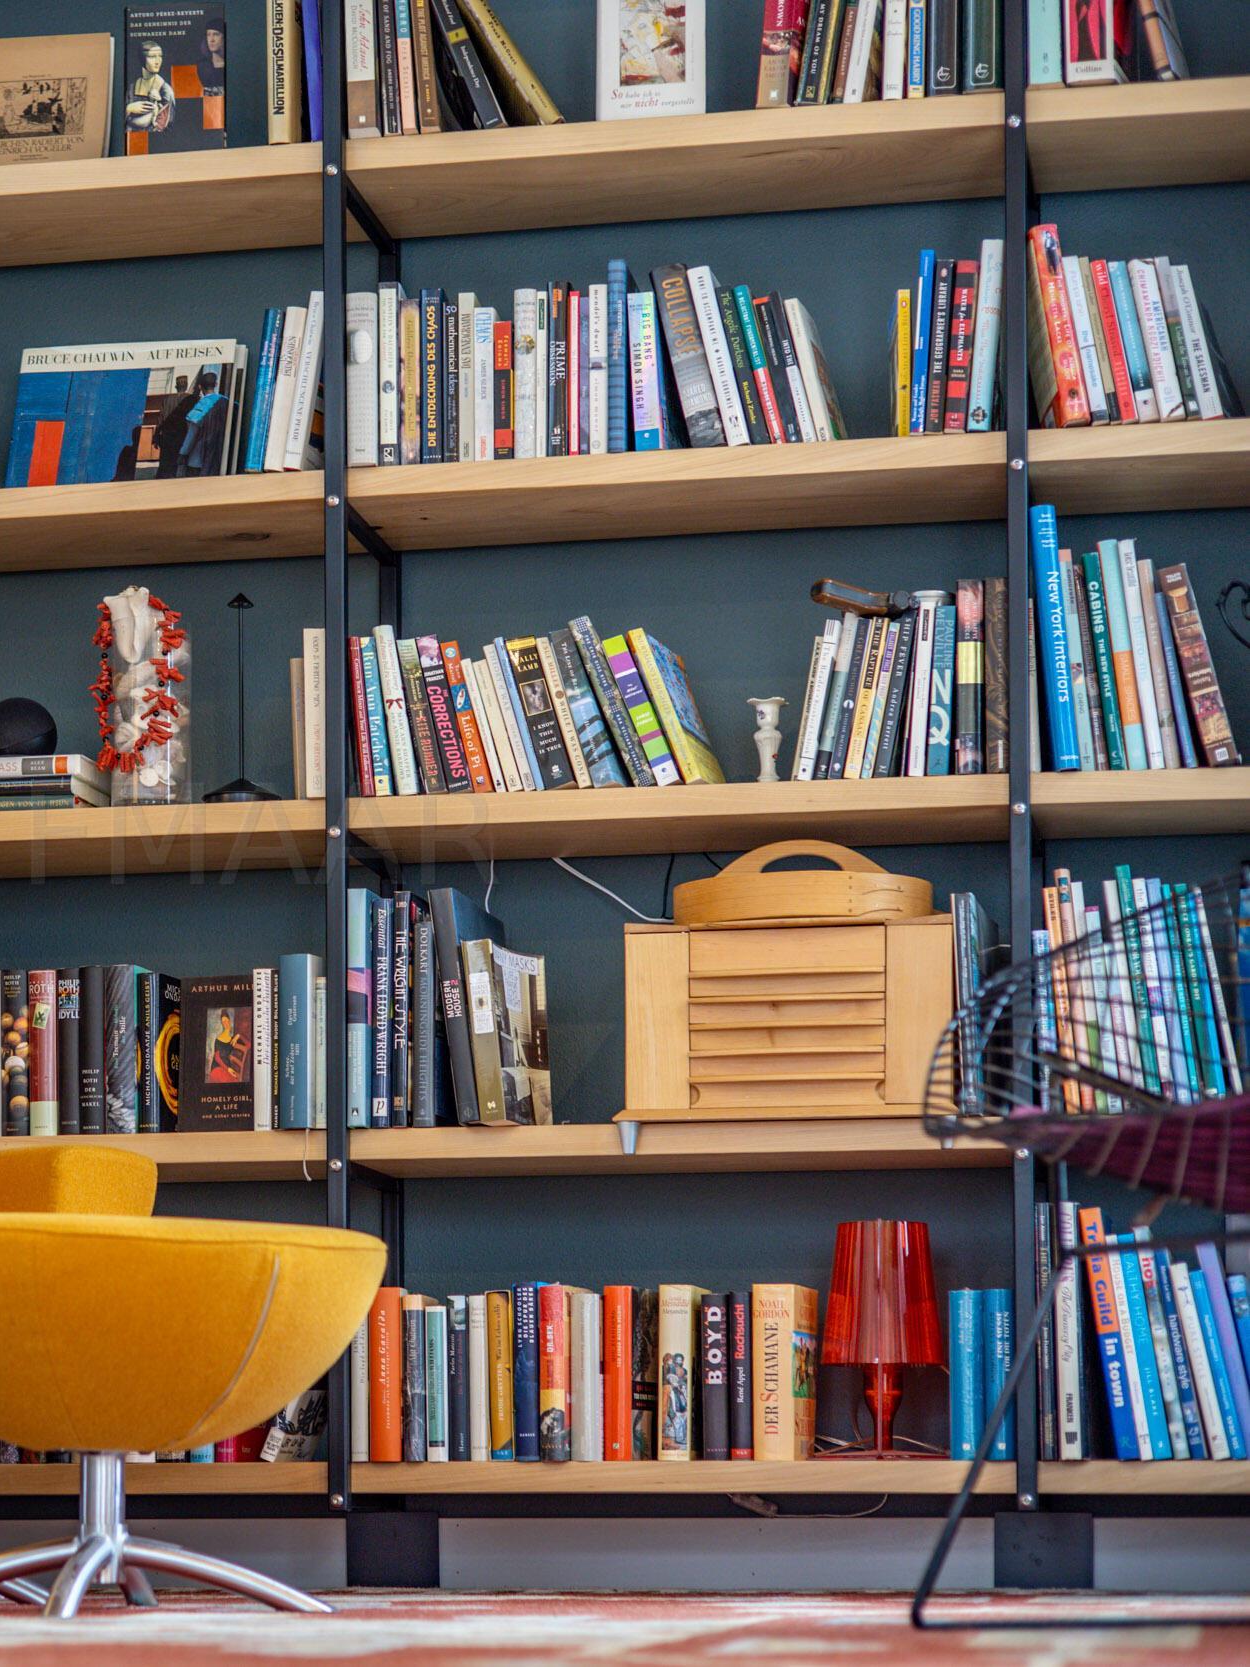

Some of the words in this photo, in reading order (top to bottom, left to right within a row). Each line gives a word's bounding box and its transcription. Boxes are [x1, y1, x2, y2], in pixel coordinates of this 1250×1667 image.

[820, 3, 826, 14] MY
[913, 9, 921, 34] GOOD
[815, 17, 824, 43] DREAM
[913, 35, 921, 54] KING
[813, 45, 821, 55] OF
[459, 45, 478, 78] Independence
[473, 76, 481, 89] Day
[810, 58, 818, 74] YOU
[913, 55, 921, 83] HARRY
[1075, 65, 1102, 73] Collins
[445, 305, 458, 316] 50
[938, 282, 948, 309] LIBRARY
[426, 304, 438, 340] CHAOS
[661, 277, 702, 357] COLLAPSE
[447, 316, 459, 373] mathematical
[935, 312, 947, 359] GEOGRAPHER'S
[1191, 337, 1200, 351] THE
[26, 353, 71, 365] BRUCE
[73, 351, 135, 363] CHATWIN
[146, 349, 174, 361] AUF
[175, 346, 225, 360] REISEN
[426, 342, 436, 361] DES
[556, 340, 565, 380] PRIME
[632, 342, 642, 375] SIMON
[933, 360, 943, 374] THE
[1194, 350, 1211, 393] SALESMAN
[426, 364, 437, 429] ENTDECKUNG
[447, 373, 458, 395] ideas
[634, 379, 645, 410] SINGH
[427, 432, 437, 448] DIE
[1046, 570, 1060, 604] New
[1050, 604, 1066, 637] York
[1089, 580, 1105, 634] CABINS
[899, 617, 912, 641] SHIP
[933, 607, 946, 671] MELVILLE
[509, 649, 539, 666] WALLY
[943, 619, 956, 672] PAULINE
[1098, 638, 1107, 653] THE
[1100, 653, 1109, 668] NEW
[362, 651, 375, 679] Run
[517, 663, 540, 673] LAMB
[895, 644, 908, 678] FEVER
[1055, 636, 1070, 703] Interiors
[366, 685, 378, 710] Ann
[1102, 669, 1113, 698] STYLE
[889, 686, 901, 718] Andrea
[415, 717, 430, 738] KITE
[426, 685, 467, 779] CORRECTIONS
[460, 715, 475, 741] Life
[537, 720, 556, 730] KNOW
[538, 729, 554, 738] THIS
[882, 719, 895, 751] Barrett
[369, 715, 385, 773] Patchett
[466, 739, 478, 754] of
[539, 737, 557, 746] MUCH
[539, 747, 547, 755] IS
[547, 743, 562, 753] TRUE
[420, 737, 439, 778] RUNNER
[470, 755, 482, 769] Pi
[378, 908, 387, 949] Essential
[395, 928, 407, 953] THE
[419, 926, 428, 974] DOLKART
[29, 984, 55, 994] ROTH
[376, 956, 387, 992] FRANK
[394, 955, 406, 1004] WRIGHT
[57, 986, 80, 994] ROTH
[442, 980, 456, 1019] MODERN
[450, 986, 463, 1018] HOUSE
[57, 1009, 80, 1019] IDYLL
[376, 993, 387, 1030] LLOYD
[418, 977, 428, 1053] MORNINGSIDE
[393, 1004, 406, 1050] STYLE
[375, 1031, 387, 1077] WRIGHT
[418, 1055, 428, 1102] HEIGHTS
[753, 1309, 790, 1319] GORDON
[757, 1299, 784, 1309] NOAH
[1096, 1278, 1114, 1326] Guild
[379, 1309, 387, 1355] Gavalda
[707, 1305, 723, 1385] BOYD
[734, 1303, 745, 1360] Rachsucht
[1103, 1337, 1119, 1355] in
[759, 1322, 779, 1403] SCHAMANE
[1168, 1314, 1184, 1361] hardware
[1177, 1363, 1189, 1390] style
[378, 1357, 387, 1385] Anna
[1105, 1358, 1125, 1408] town
[763, 1405, 779, 1435] DER
[1065, 1392, 1074, 1424] FRANKEN
